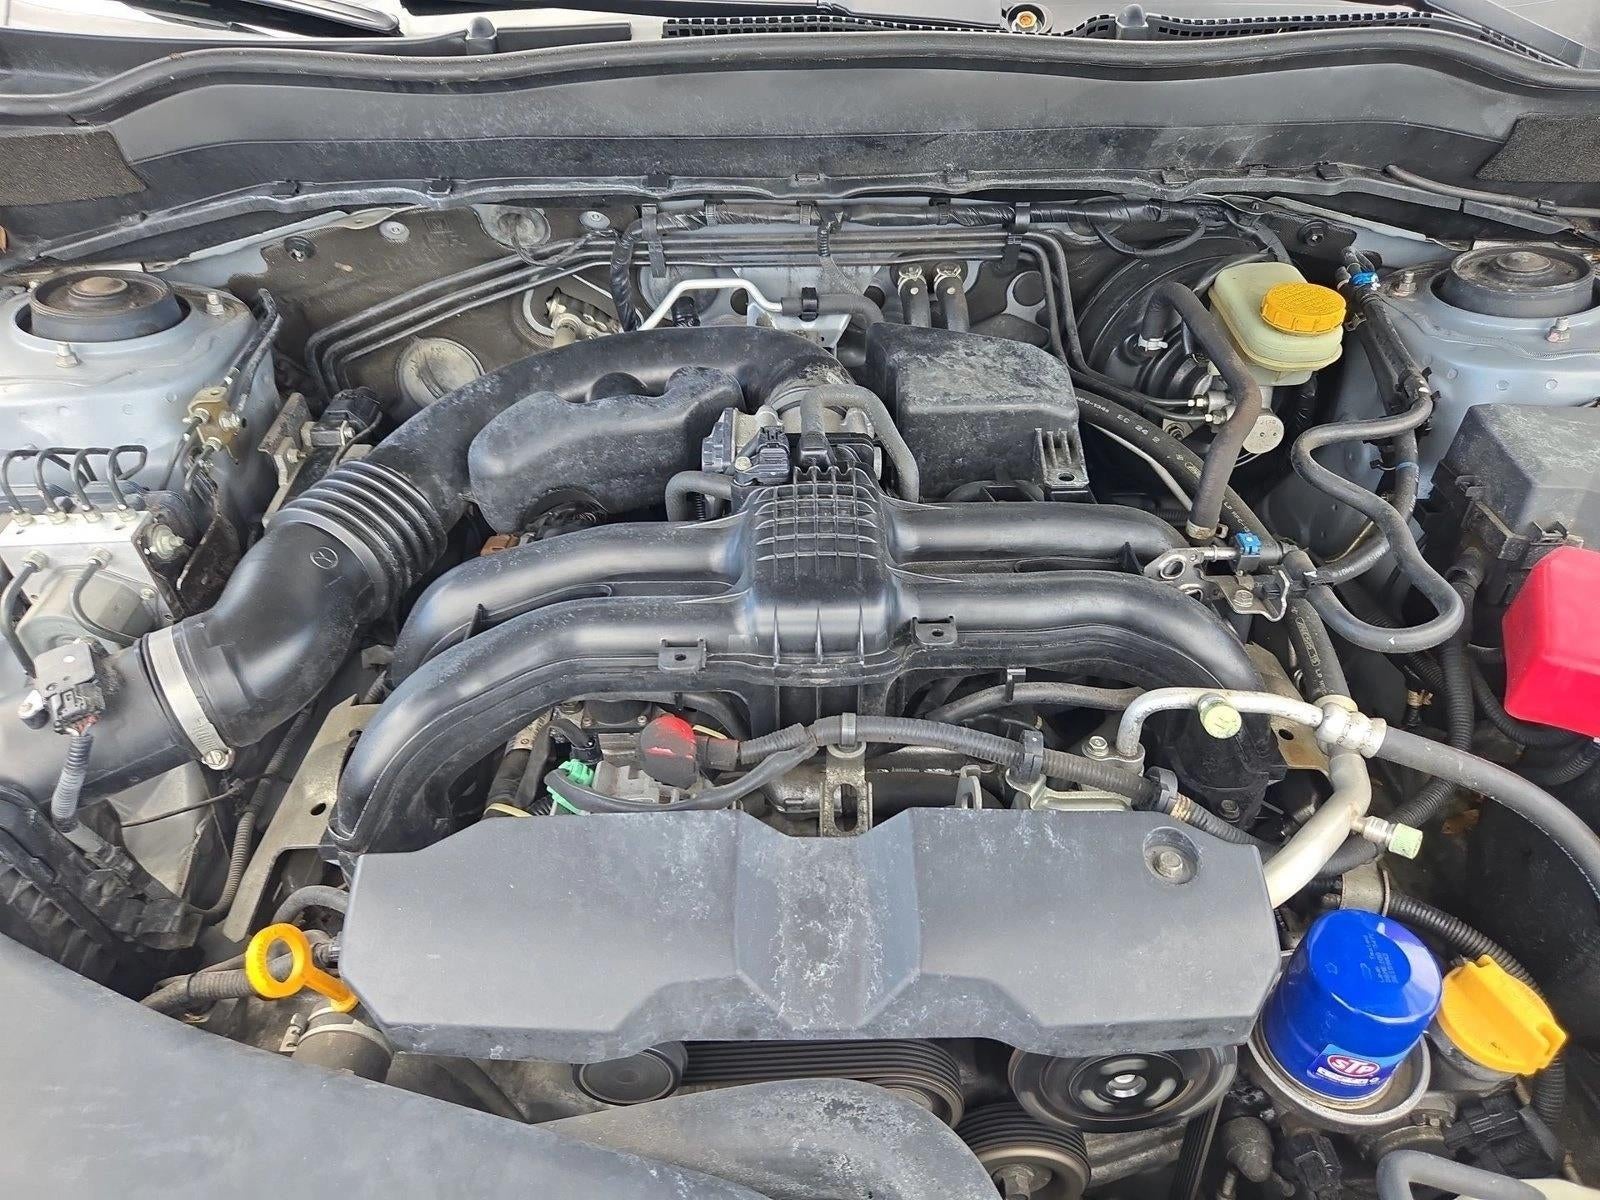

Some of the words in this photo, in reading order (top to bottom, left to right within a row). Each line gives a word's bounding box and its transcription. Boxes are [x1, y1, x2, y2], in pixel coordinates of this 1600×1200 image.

[1116, 414, 1131, 424] EC
[1134, 424, 1149, 435] 24
[1331, 1057, 1377, 1075] STP
